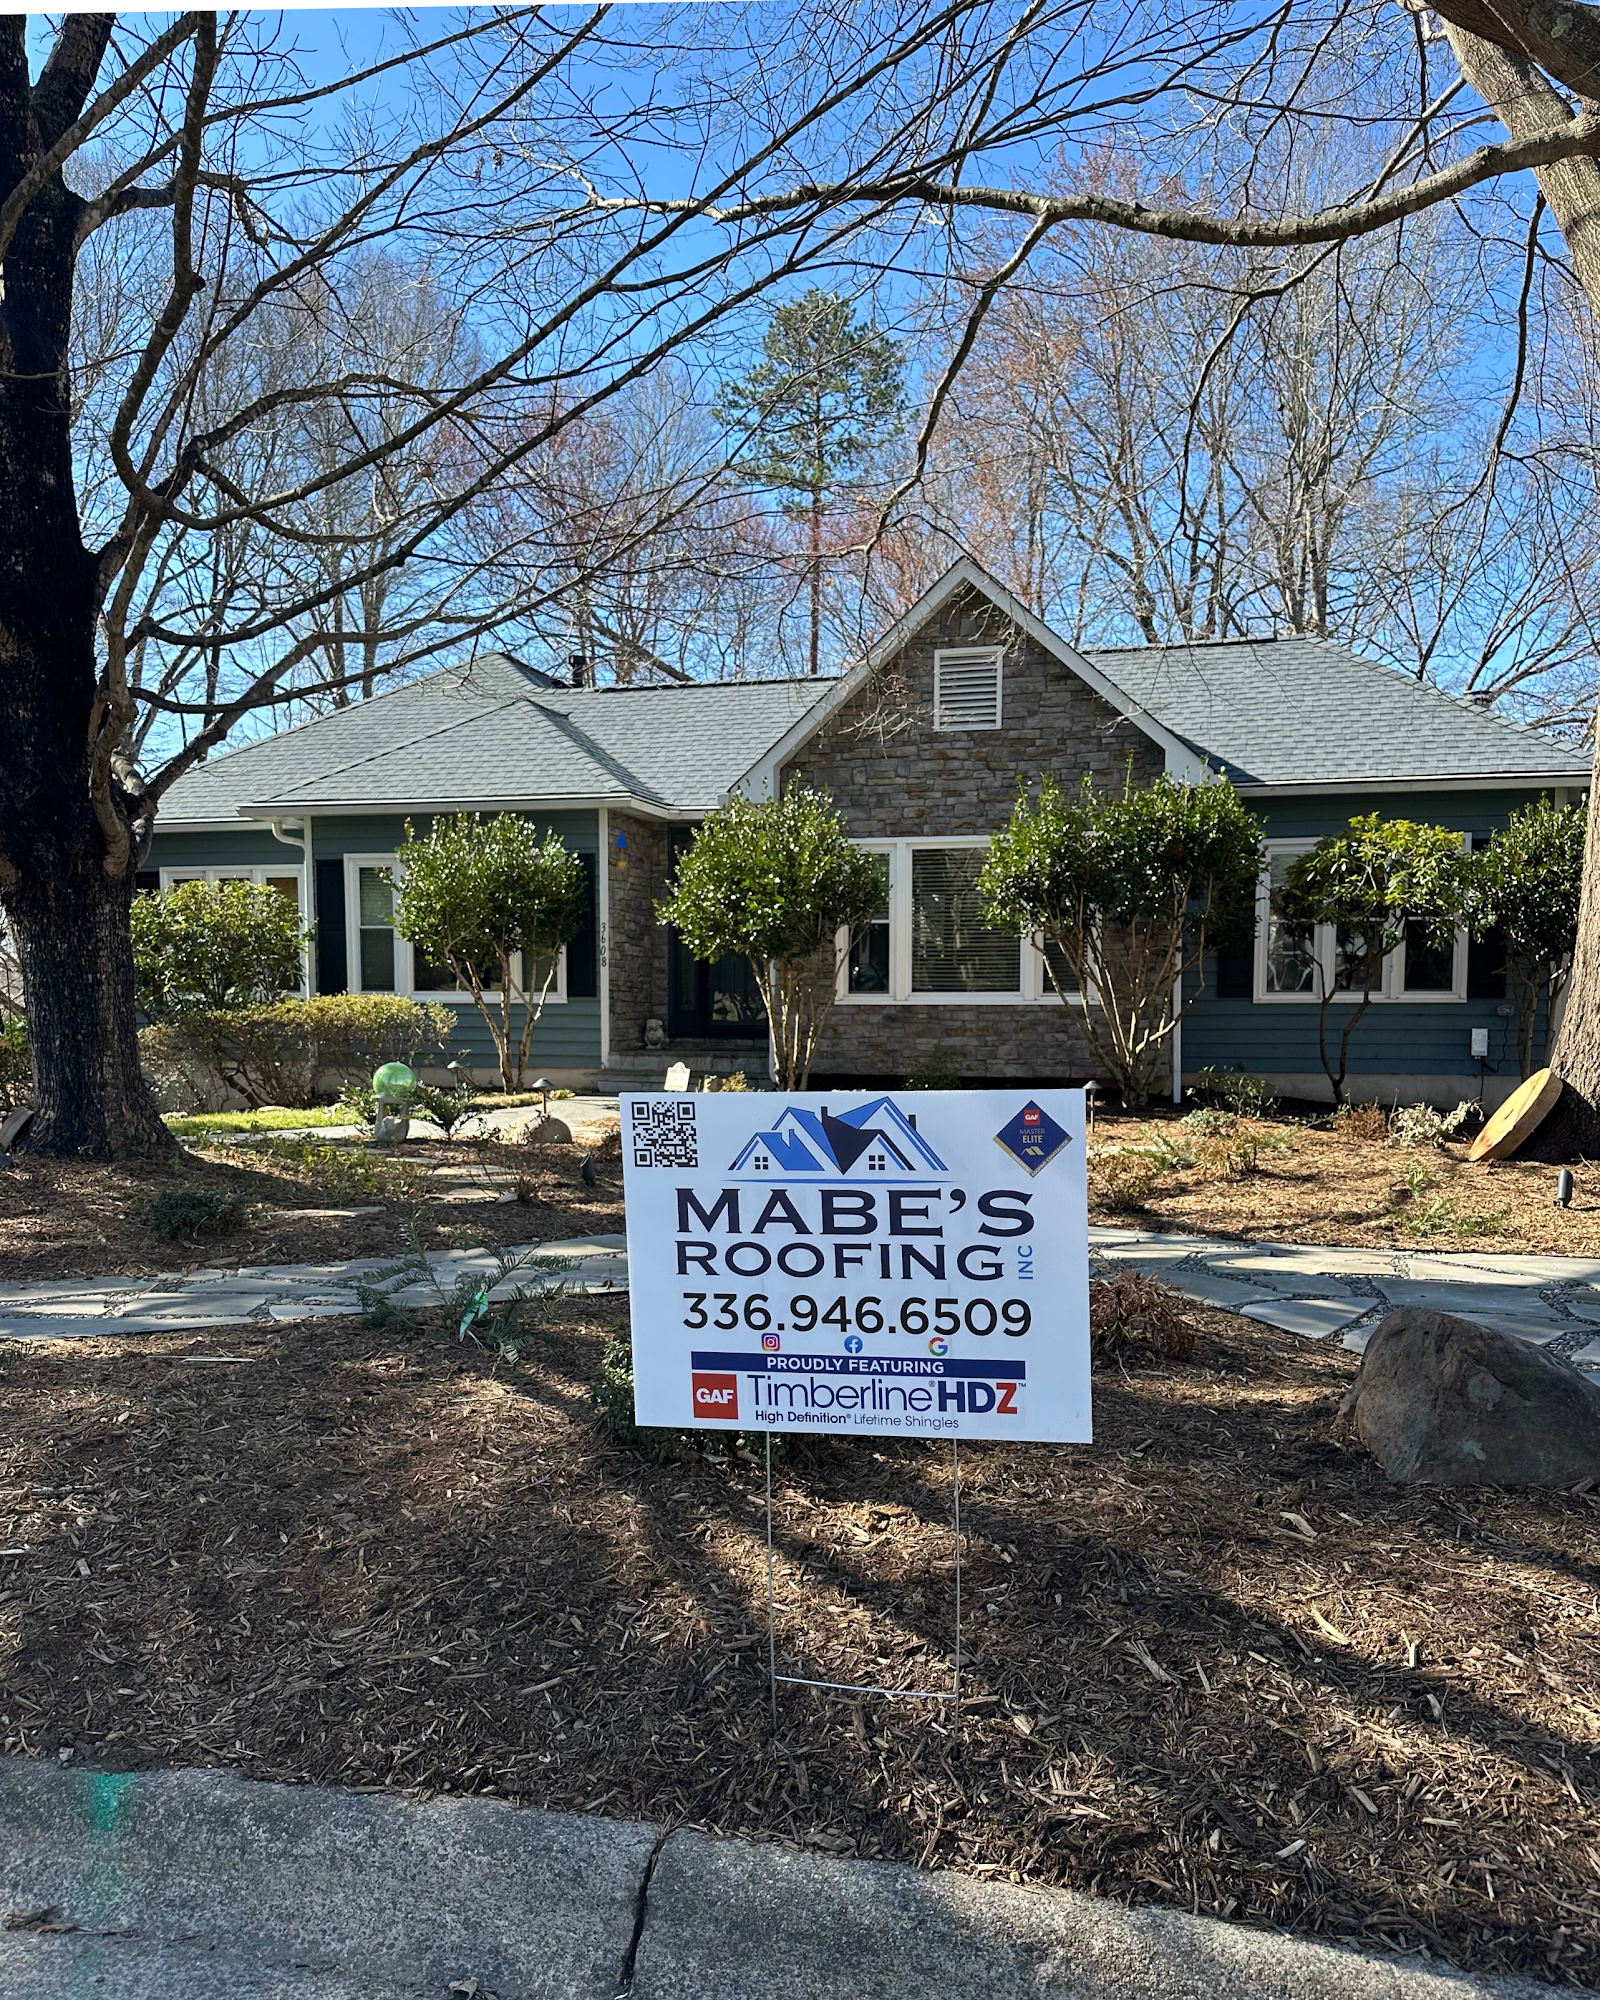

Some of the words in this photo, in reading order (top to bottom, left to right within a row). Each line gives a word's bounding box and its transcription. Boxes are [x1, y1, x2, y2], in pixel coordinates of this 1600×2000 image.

[1022, 1135, 1043, 1144] ELITE
[675, 1188, 1035, 1237] MABE'S
[675, 1240, 1005, 1281] ROOFING
[1017, 1245, 1034, 1280] INC
[683, 1292, 1032, 1337] 336.946.6509
[767, 1356, 843, 1371] PROUDLY
[849, 1359, 945, 1374] FEATURING
[696, 1387, 735, 1405] GAF
[755, 1410, 784, 1424] High
[854, 1414, 902, 1426] Lifetime
[905, 1415, 960, 1431] Shingles
